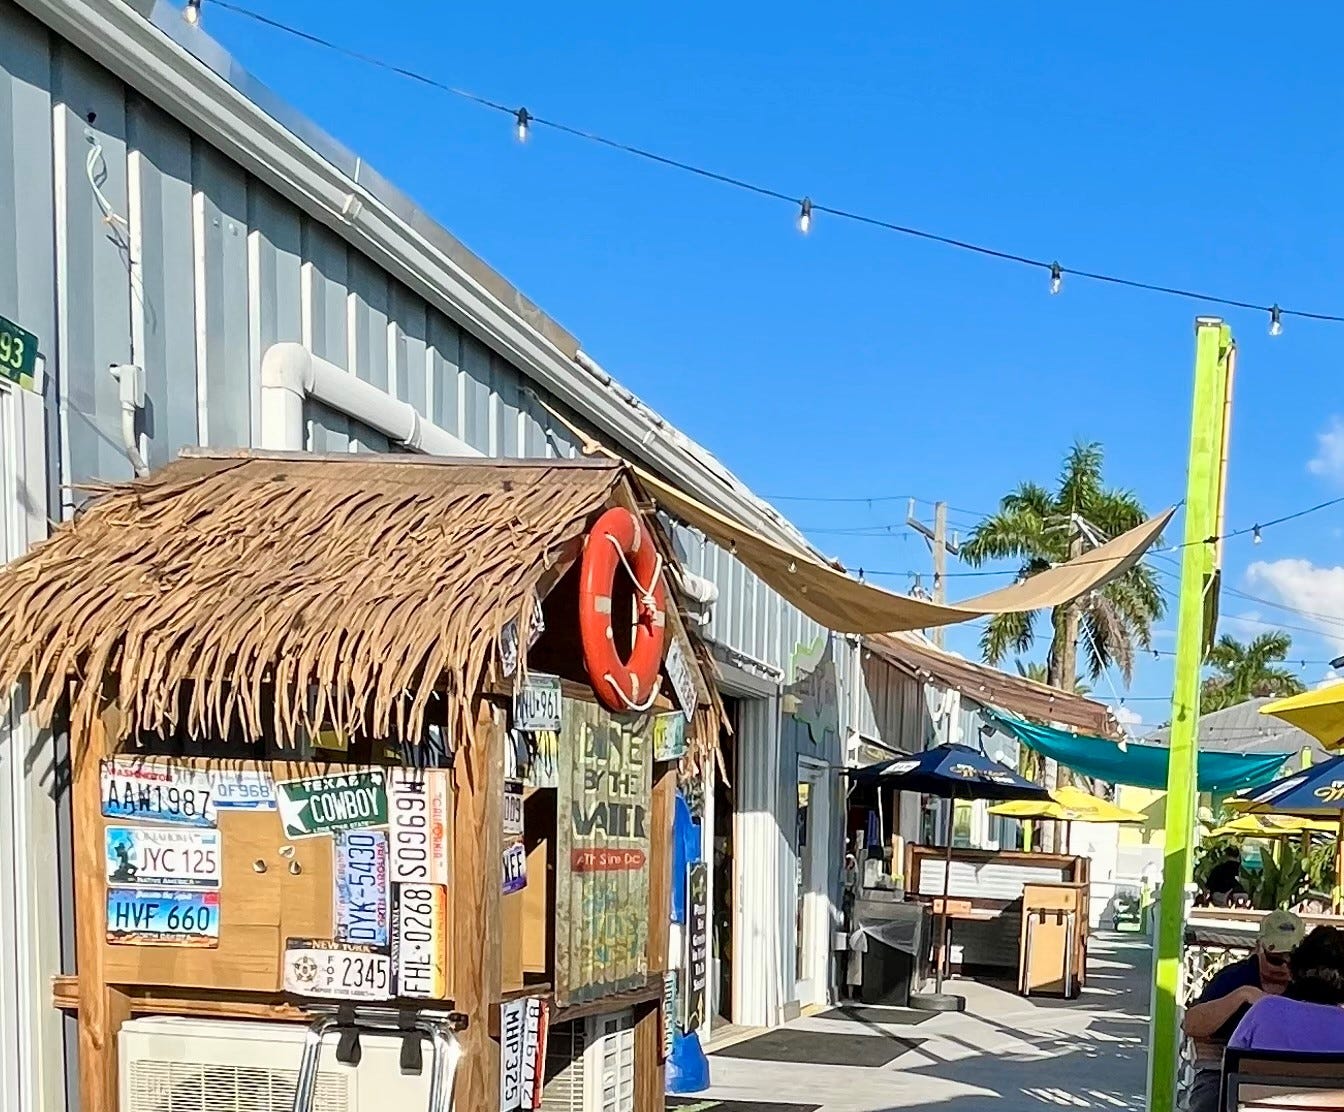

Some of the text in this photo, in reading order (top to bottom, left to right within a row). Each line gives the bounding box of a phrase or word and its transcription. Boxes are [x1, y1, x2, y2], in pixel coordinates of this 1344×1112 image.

[310, 787, 379, 823] COWBOY
[141, 848, 216, 873] JYC 125
[348, 835, 376, 940] DYK-5430
[116, 902, 210, 931] HVF 660
[312, 939, 340, 949] NEW
[342, 957, 386, 989] 2345
